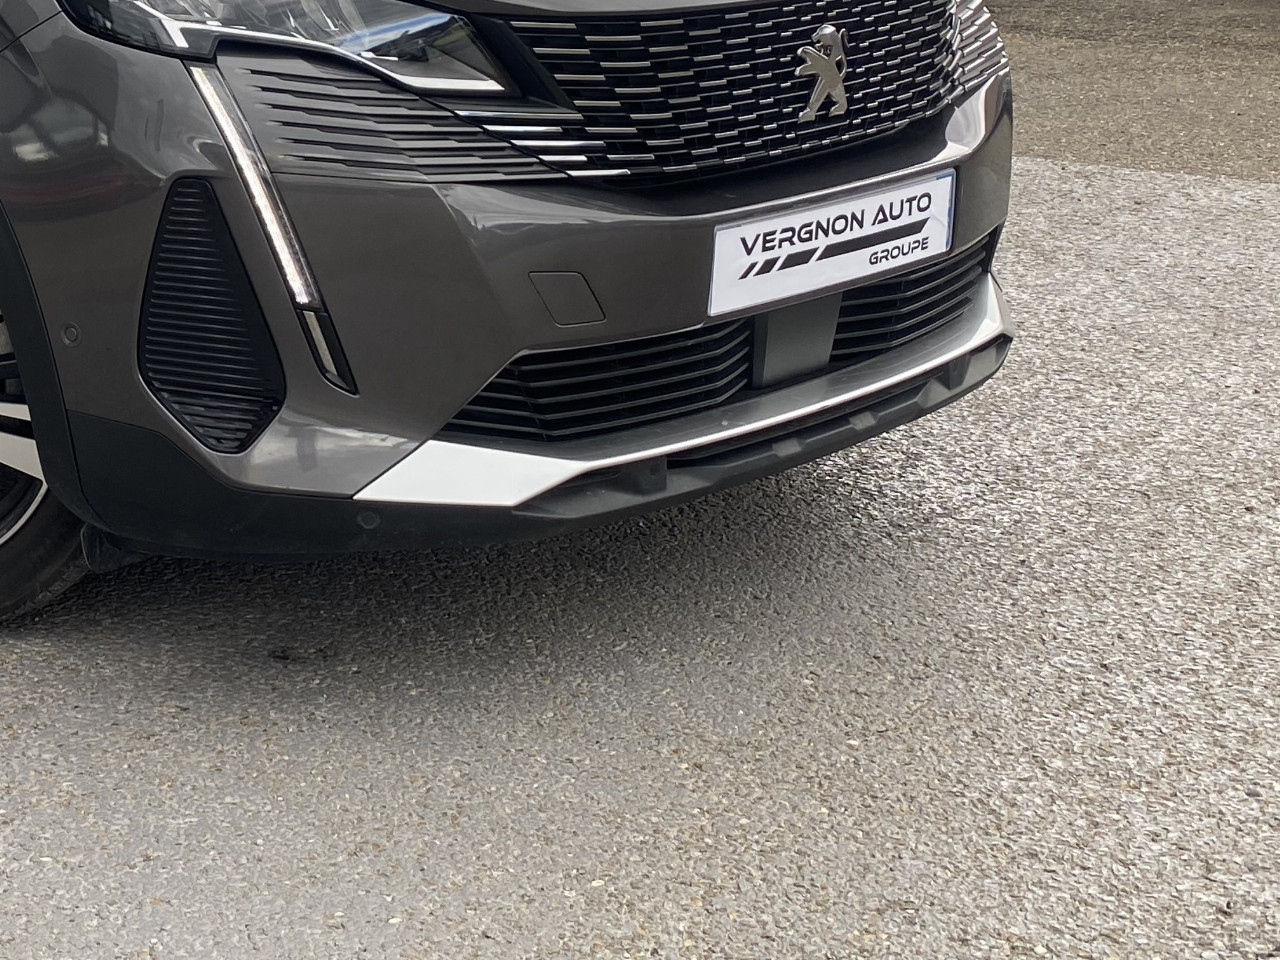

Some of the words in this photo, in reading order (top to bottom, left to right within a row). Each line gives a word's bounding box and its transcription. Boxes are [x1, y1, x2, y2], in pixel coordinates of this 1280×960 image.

[740, 209, 866, 256] VERGNON
[871, 191, 933, 227] AUTO
[869, 236, 930, 266] GROUPE
